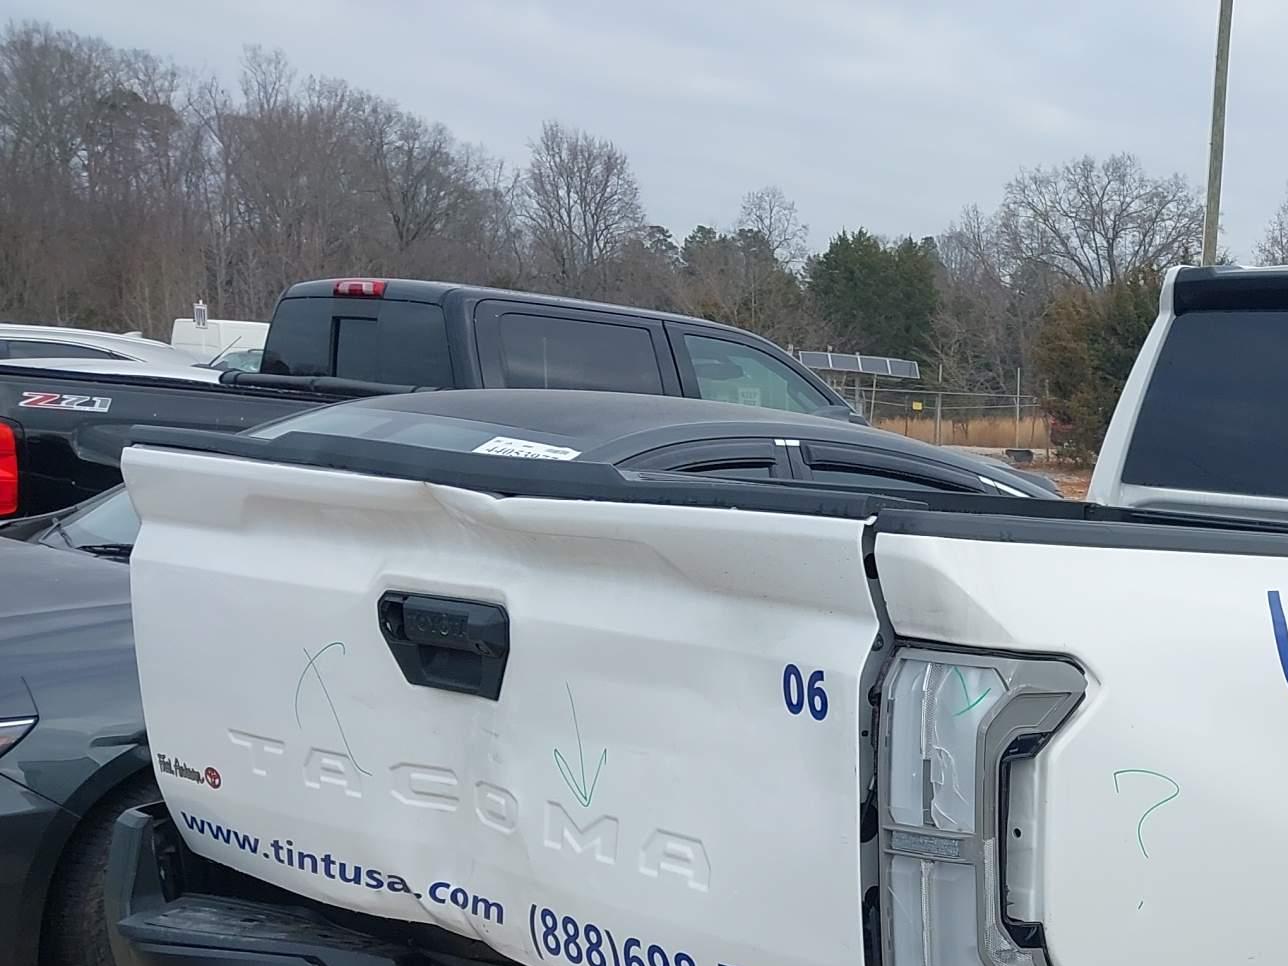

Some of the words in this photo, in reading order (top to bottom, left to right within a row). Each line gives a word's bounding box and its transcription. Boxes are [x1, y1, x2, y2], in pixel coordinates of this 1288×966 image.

[19, 392, 112, 412] Z71
[783, 663, 830, 721] 06
[228, 728, 711, 892] TACOMA
[181, 810, 505, 924] www.tintusa.com
